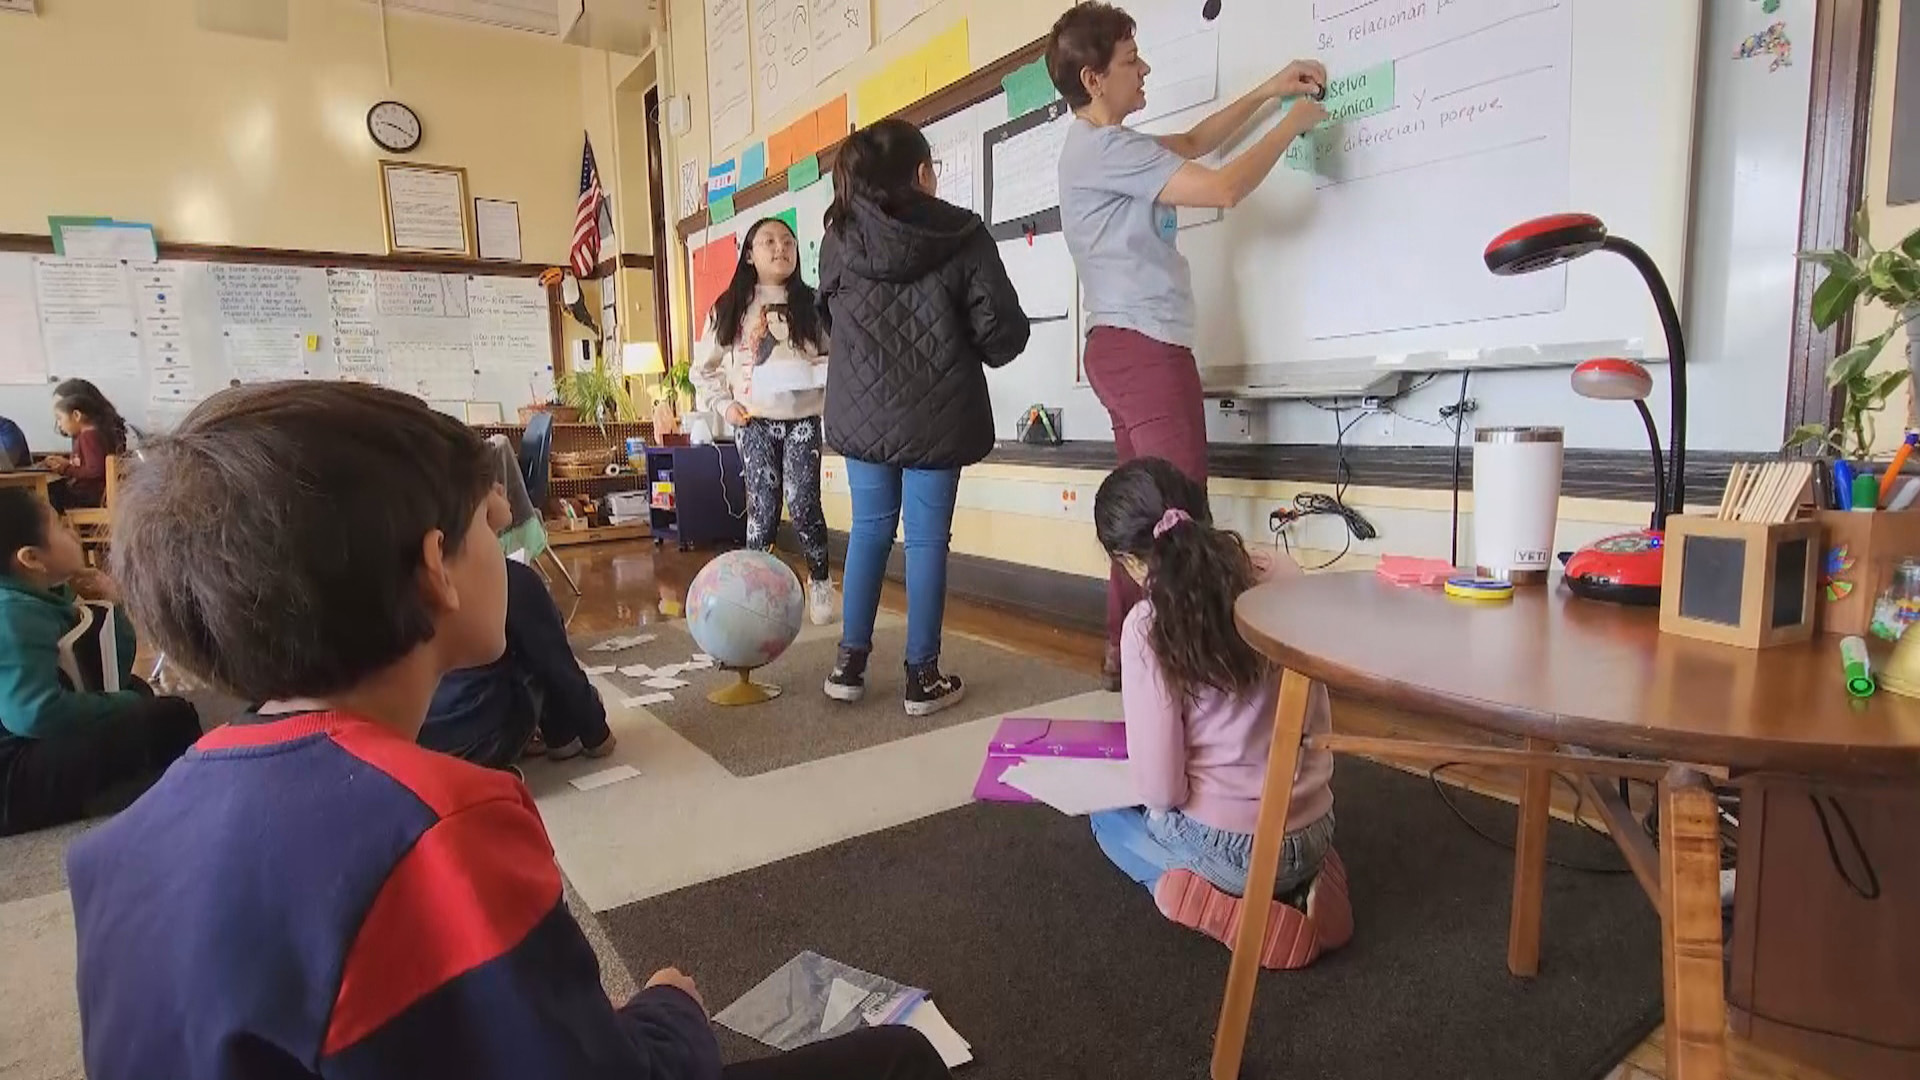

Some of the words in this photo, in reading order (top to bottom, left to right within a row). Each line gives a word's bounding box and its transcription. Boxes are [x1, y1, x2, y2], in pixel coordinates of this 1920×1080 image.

[1348, 2, 1426, 41] relacionan
[1329, 74, 1367, 98] Selva
[1343, 117, 1425, 153] diferecian
[1440, 97, 1503, 128] porque
[1518, 551, 1547, 561] YETI
